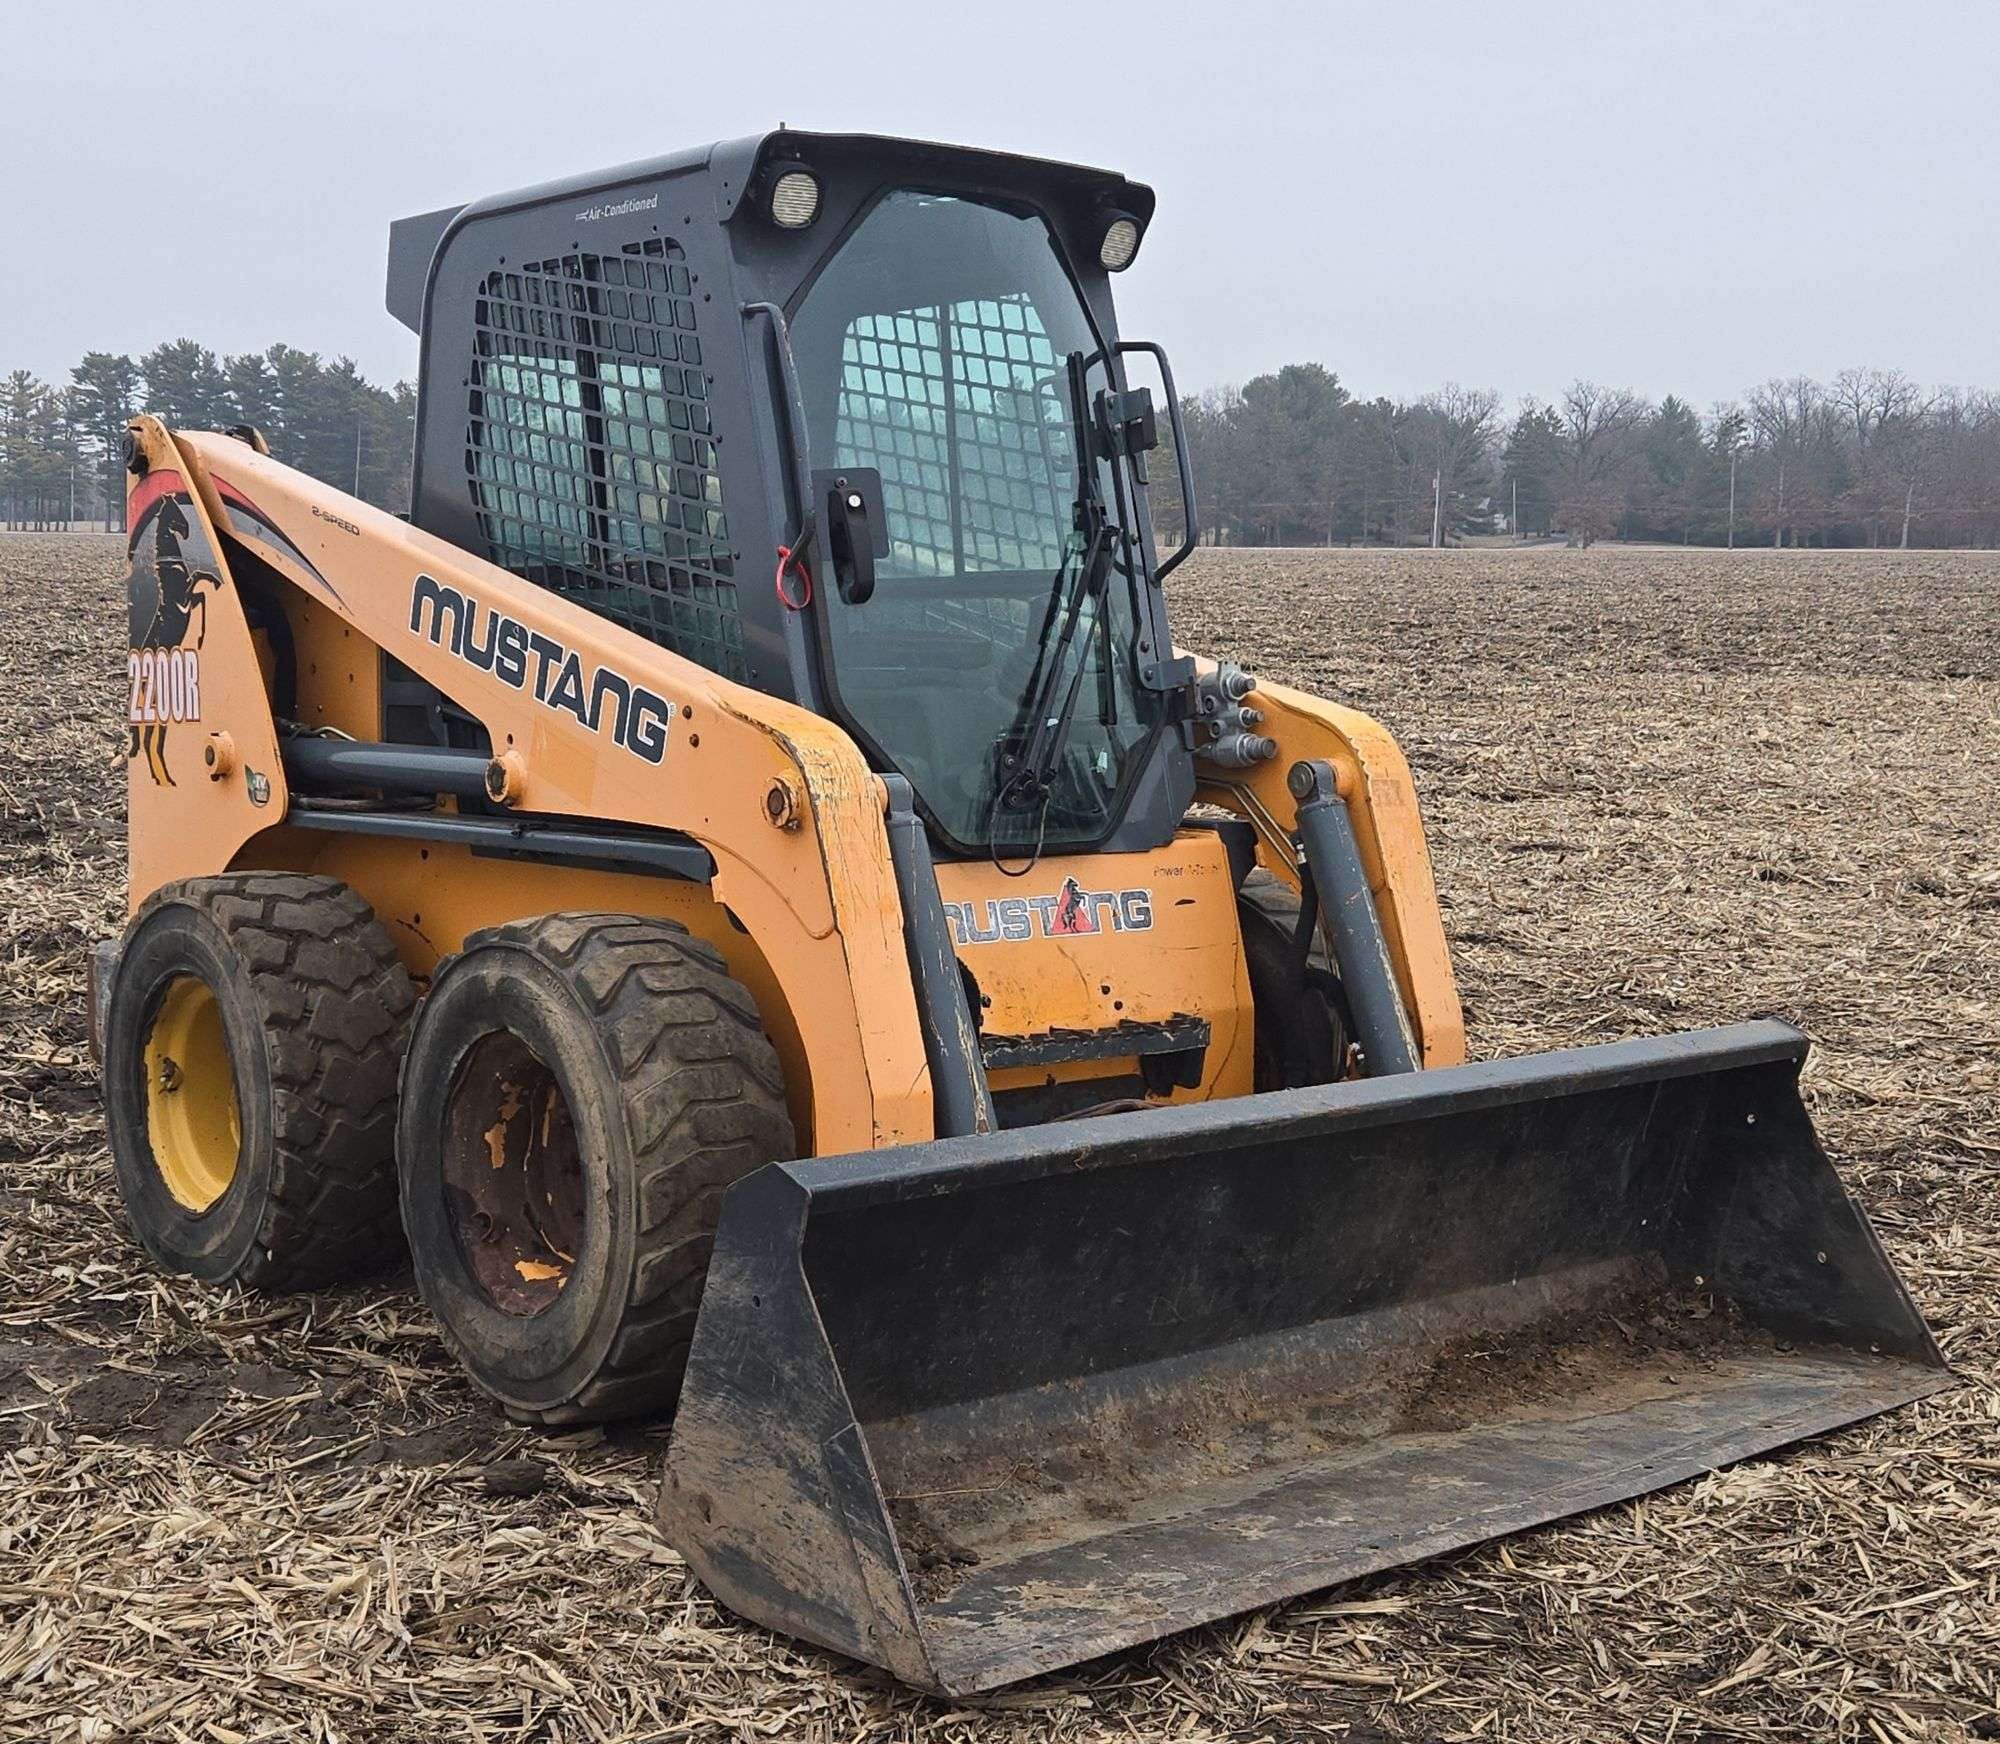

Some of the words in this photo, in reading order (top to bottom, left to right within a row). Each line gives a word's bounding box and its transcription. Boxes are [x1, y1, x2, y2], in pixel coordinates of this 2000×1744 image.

[588, 193, 659, 221] Air-Conditioned
[311, 504, 360, 536] 2-SPEED
[128, 646, 201, 724] 2200R
[410, 573, 670, 766] MUSTANG
